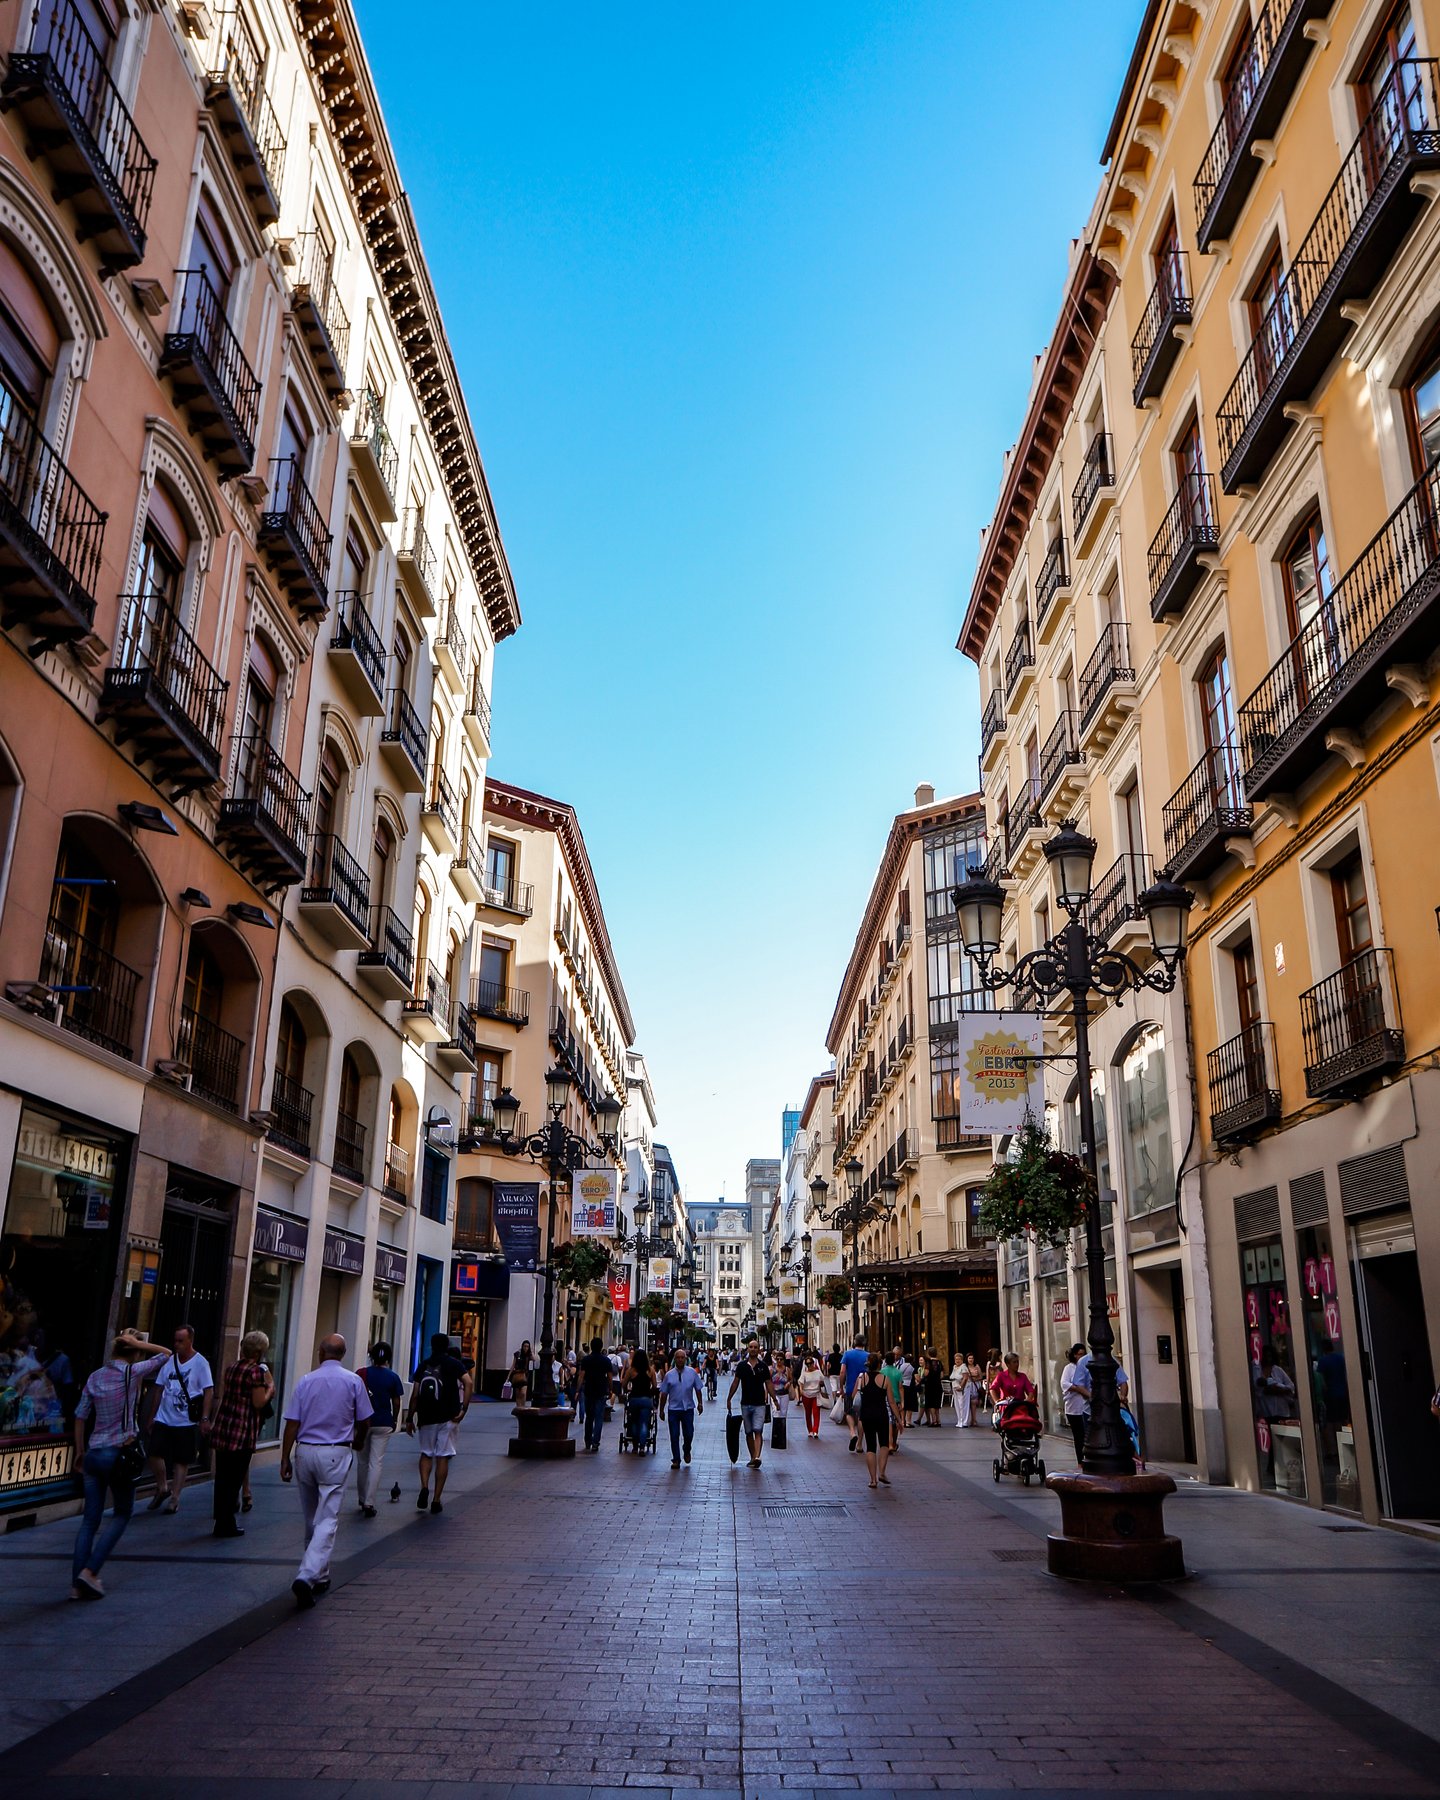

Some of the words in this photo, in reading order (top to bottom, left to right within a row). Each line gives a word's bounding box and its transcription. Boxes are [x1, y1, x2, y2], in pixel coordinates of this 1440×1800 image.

[978, 1044, 1024, 1056] Festivales
[988, 1078, 1016, 1088] 2013
[615, 1266, 624, 1292] GOYA
[1309, 1264, 1316, 1294] 4
[1324, 1263, 1331, 1294] 1
[1326, 1308, 1339, 1339] 12
